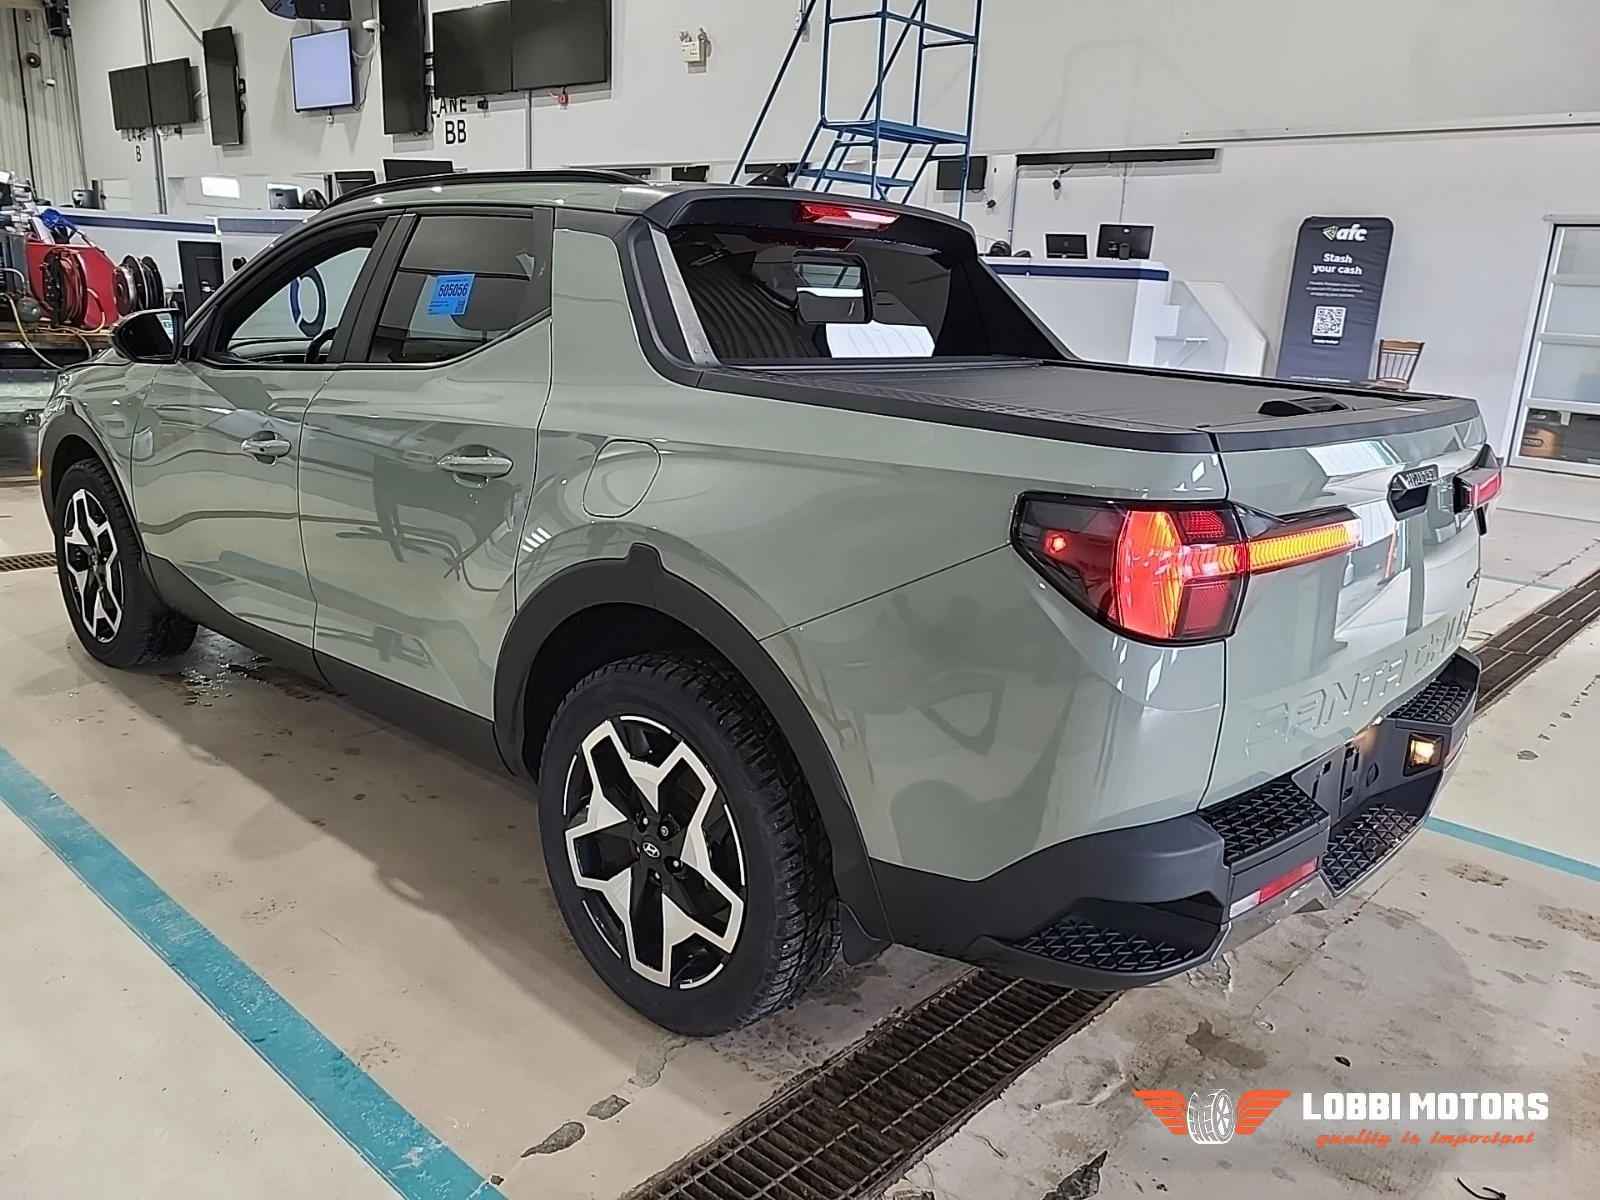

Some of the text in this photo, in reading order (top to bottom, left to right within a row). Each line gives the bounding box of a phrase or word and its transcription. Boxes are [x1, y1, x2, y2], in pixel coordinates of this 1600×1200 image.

[445, 119, 467, 145] BB
[136, 145, 142, 162] B
[1335, 223, 1368, 242] afc
[1322, 252, 1353, 264] Stash
[1311, 264, 1363, 276] your cash
[438, 283, 469, 298] 505056
